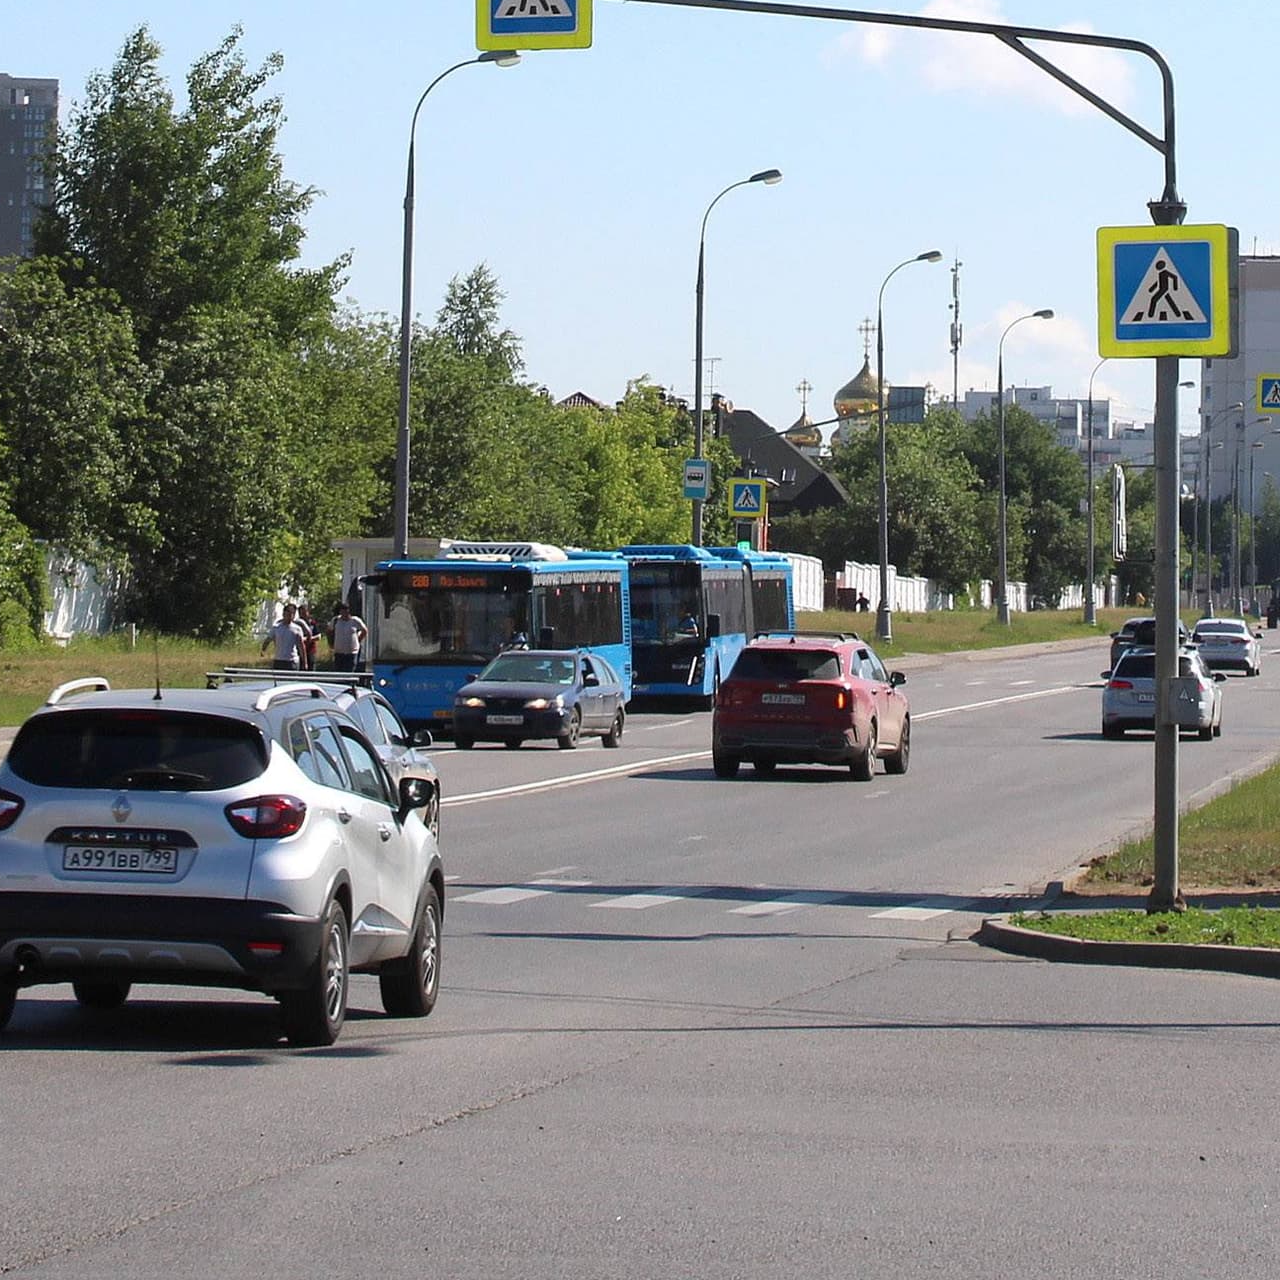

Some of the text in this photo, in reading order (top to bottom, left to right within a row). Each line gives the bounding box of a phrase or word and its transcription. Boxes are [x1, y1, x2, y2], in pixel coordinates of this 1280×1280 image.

[71, 832, 169, 842] KAPTUR
[70, 849, 171, 868] А991ВВ 799
